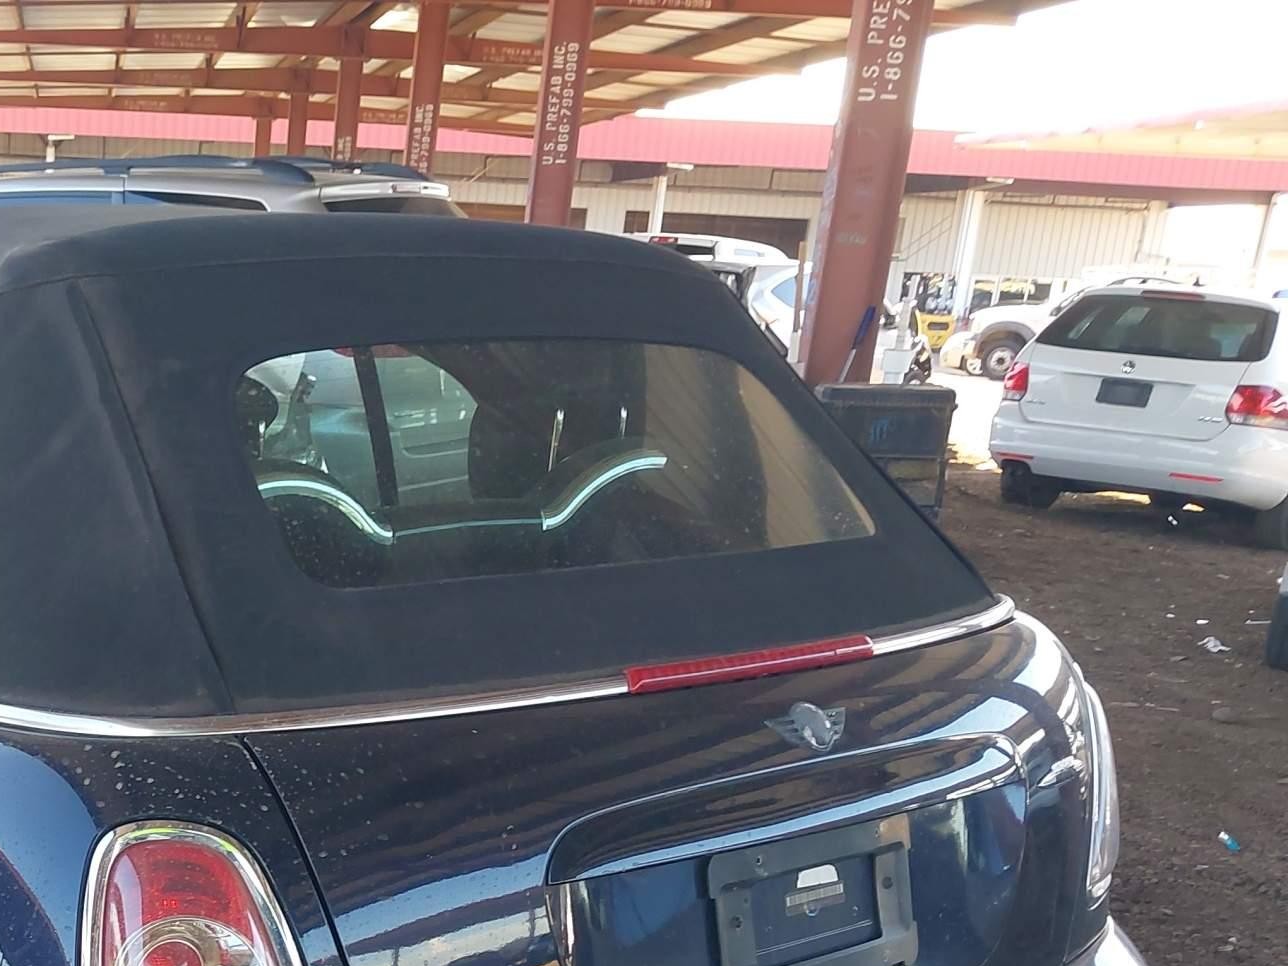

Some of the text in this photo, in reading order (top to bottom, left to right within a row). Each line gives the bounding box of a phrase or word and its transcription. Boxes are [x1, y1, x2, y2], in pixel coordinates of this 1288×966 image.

[552, 41, 567, 69] INC.
[857, 58, 882, 101] U.S.
[545, 76, 562, 131] PREFAB
[555, 42, 580, 164] 1-866-799-0969
